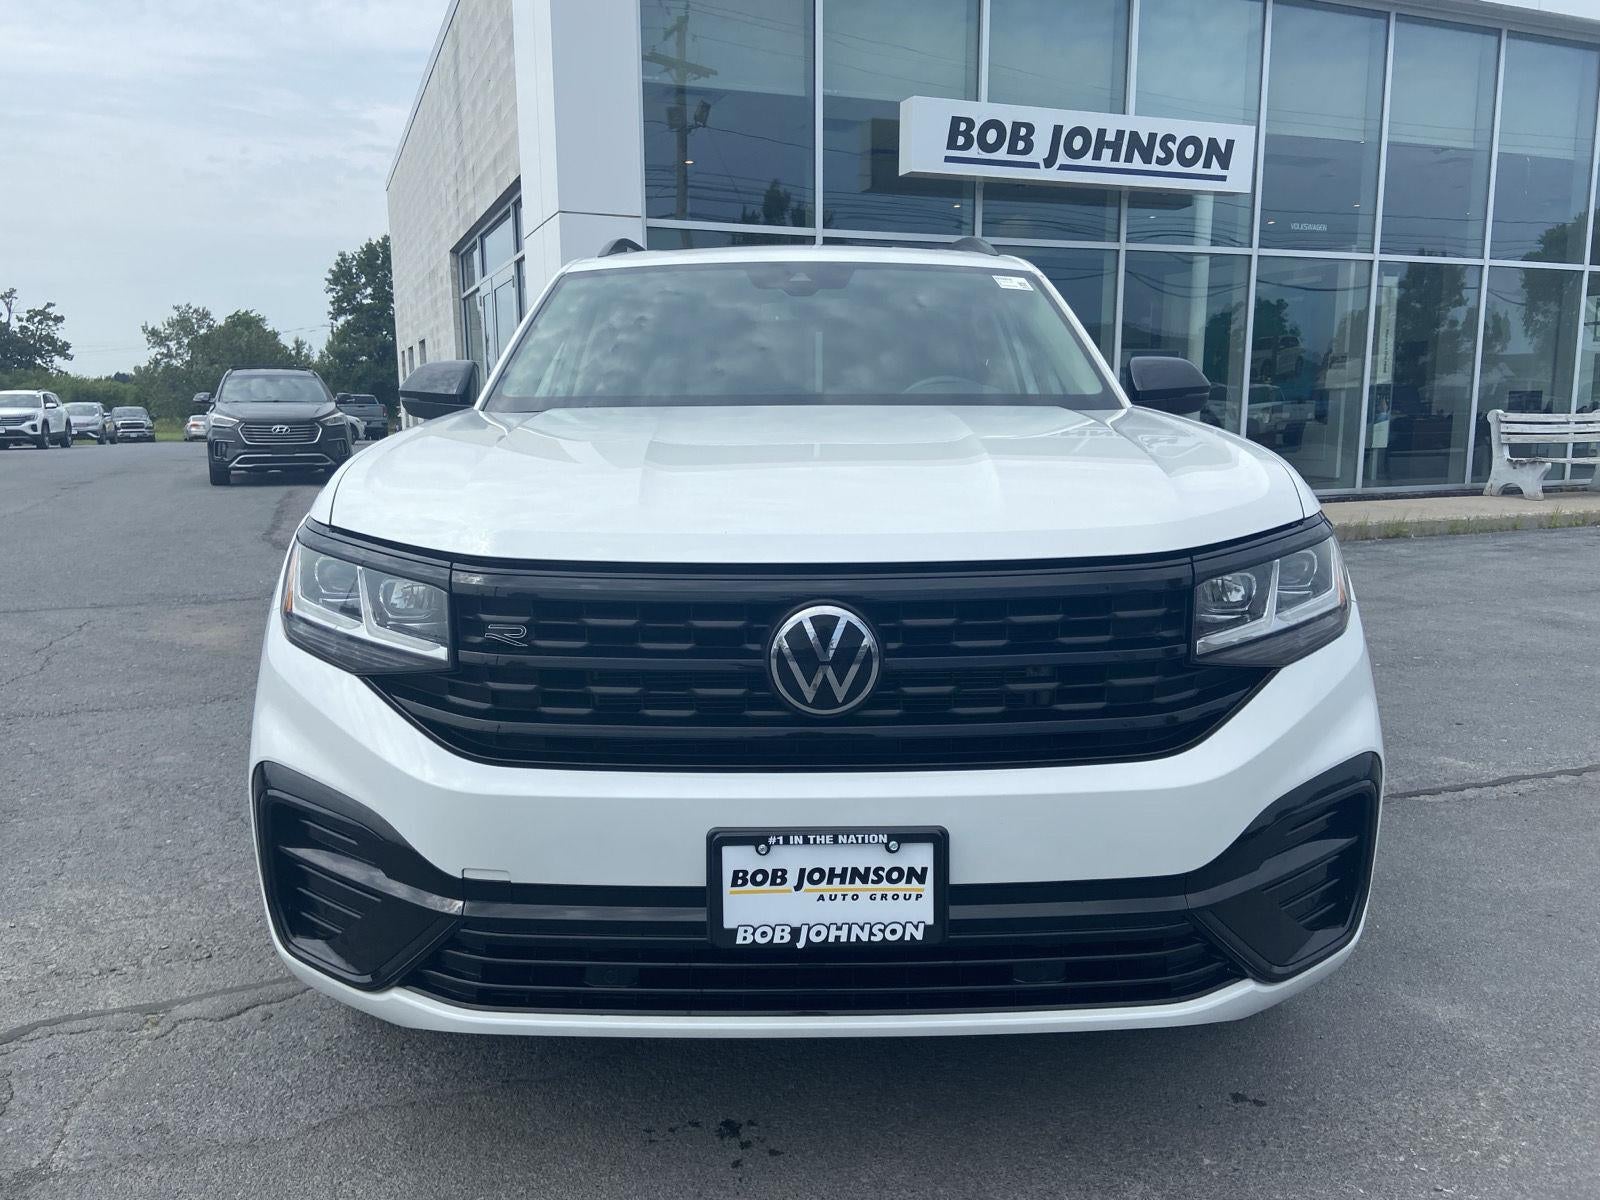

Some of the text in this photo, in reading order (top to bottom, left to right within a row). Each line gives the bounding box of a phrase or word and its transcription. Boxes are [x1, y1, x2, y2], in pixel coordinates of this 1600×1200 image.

[946, 115, 1236, 171] BOB JOHNSON
[1290, 222, 1328, 231] VOLKSWAGEN
[768, 833, 888, 846] #1 IN THE NATION
[730, 866, 929, 892] BOB JOHNSON
[816, 892, 923, 902] AUTO GROUP
[735, 922, 926, 949] BOB JOHNSON
